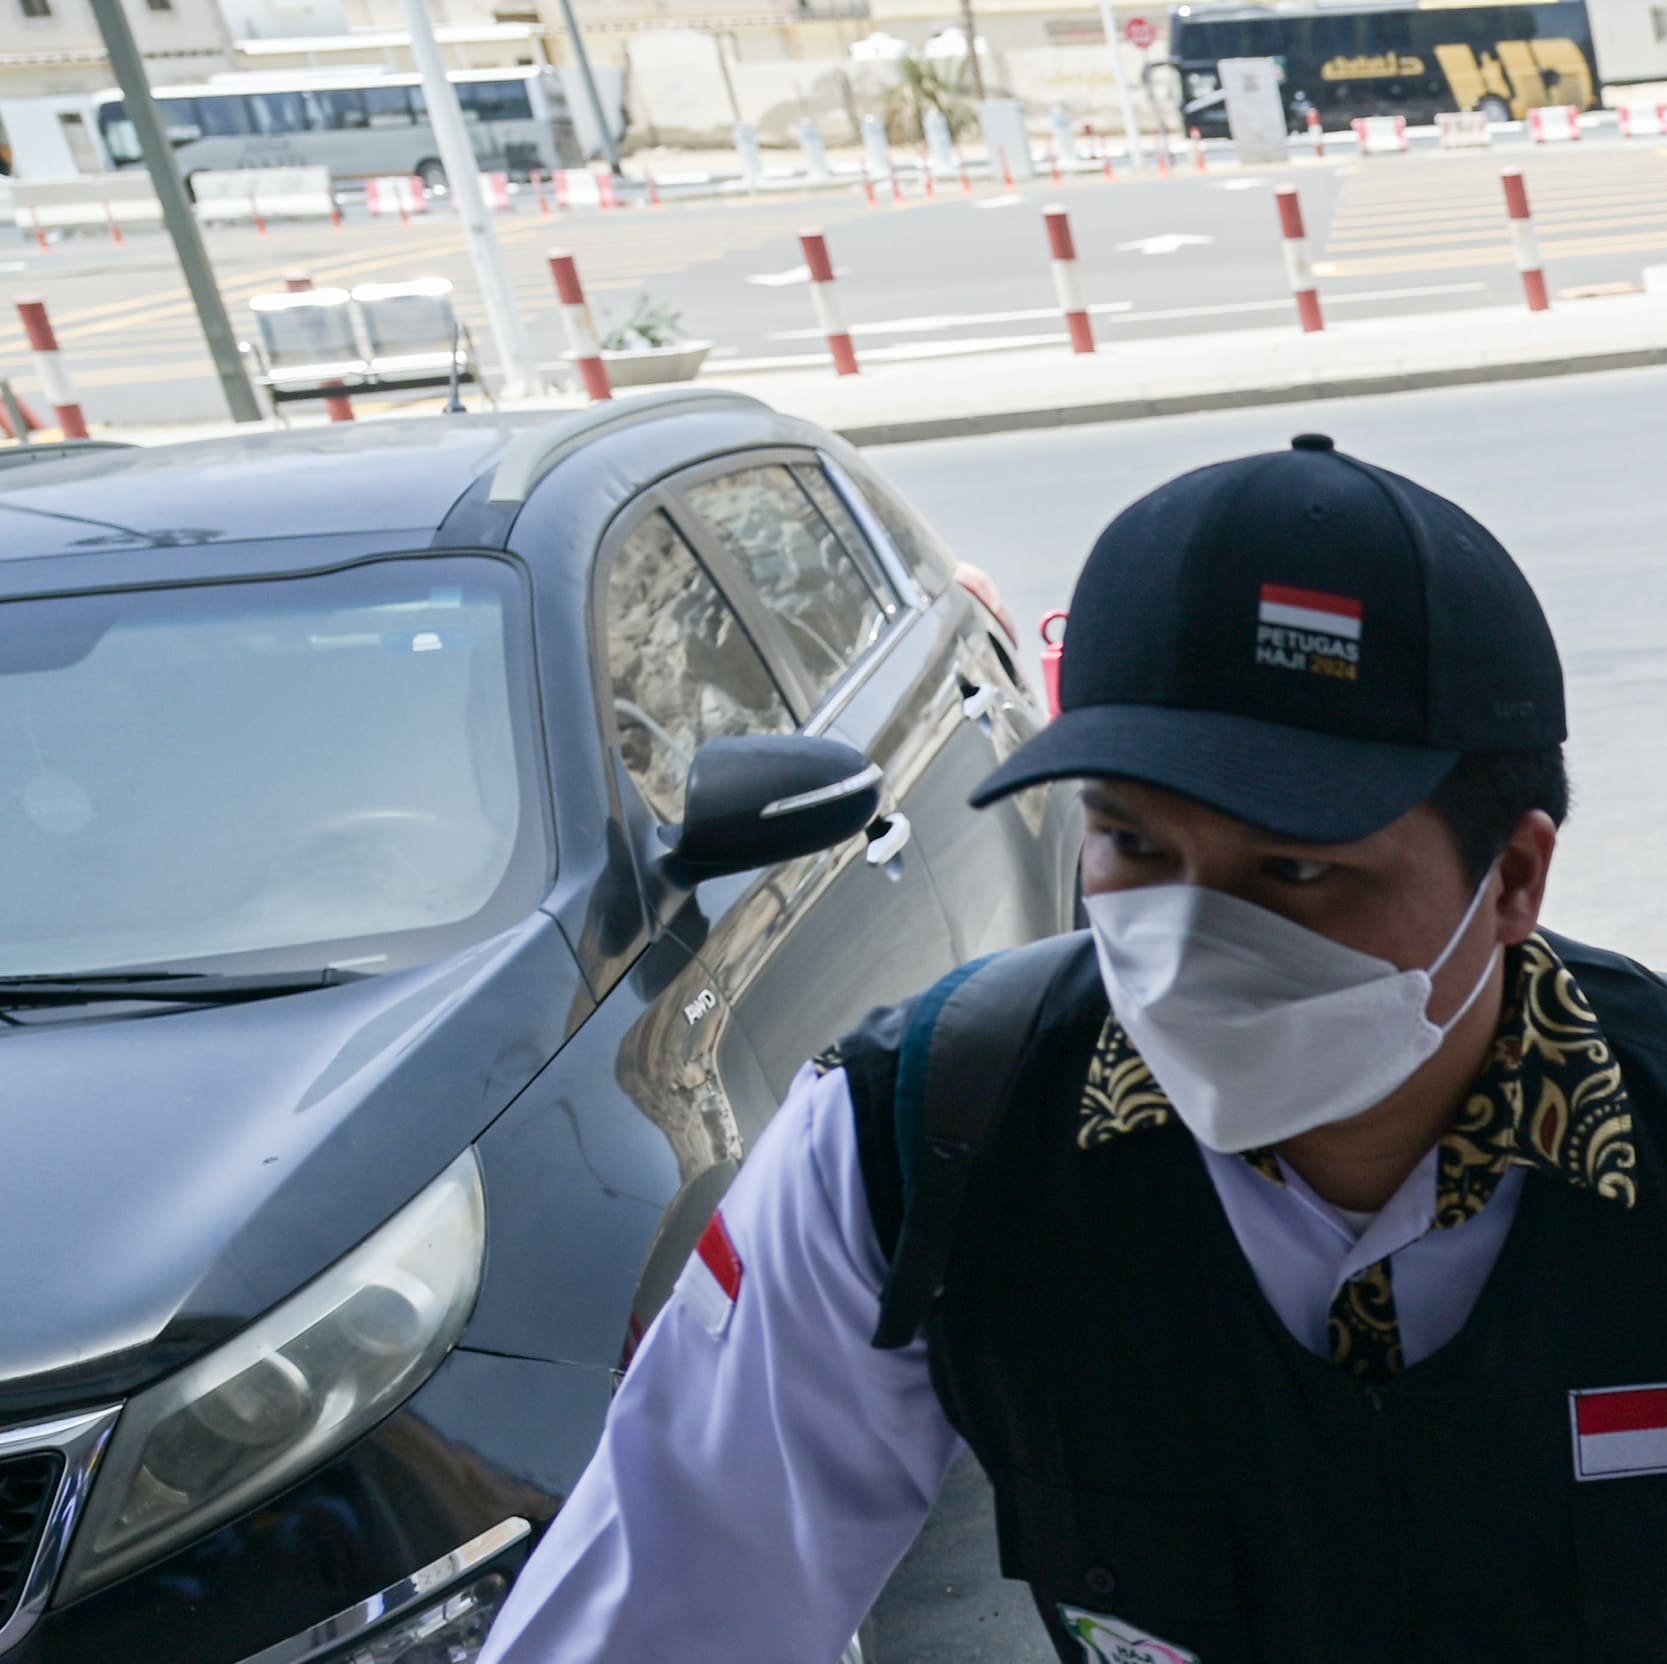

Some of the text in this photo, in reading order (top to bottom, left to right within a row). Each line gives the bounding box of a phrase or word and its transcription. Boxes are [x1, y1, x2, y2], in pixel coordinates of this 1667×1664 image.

[1255, 647, 1307, 670] HAJI
[1257, 625, 1359, 661] PETUGAS
[683, 988, 717, 1026] AWD
